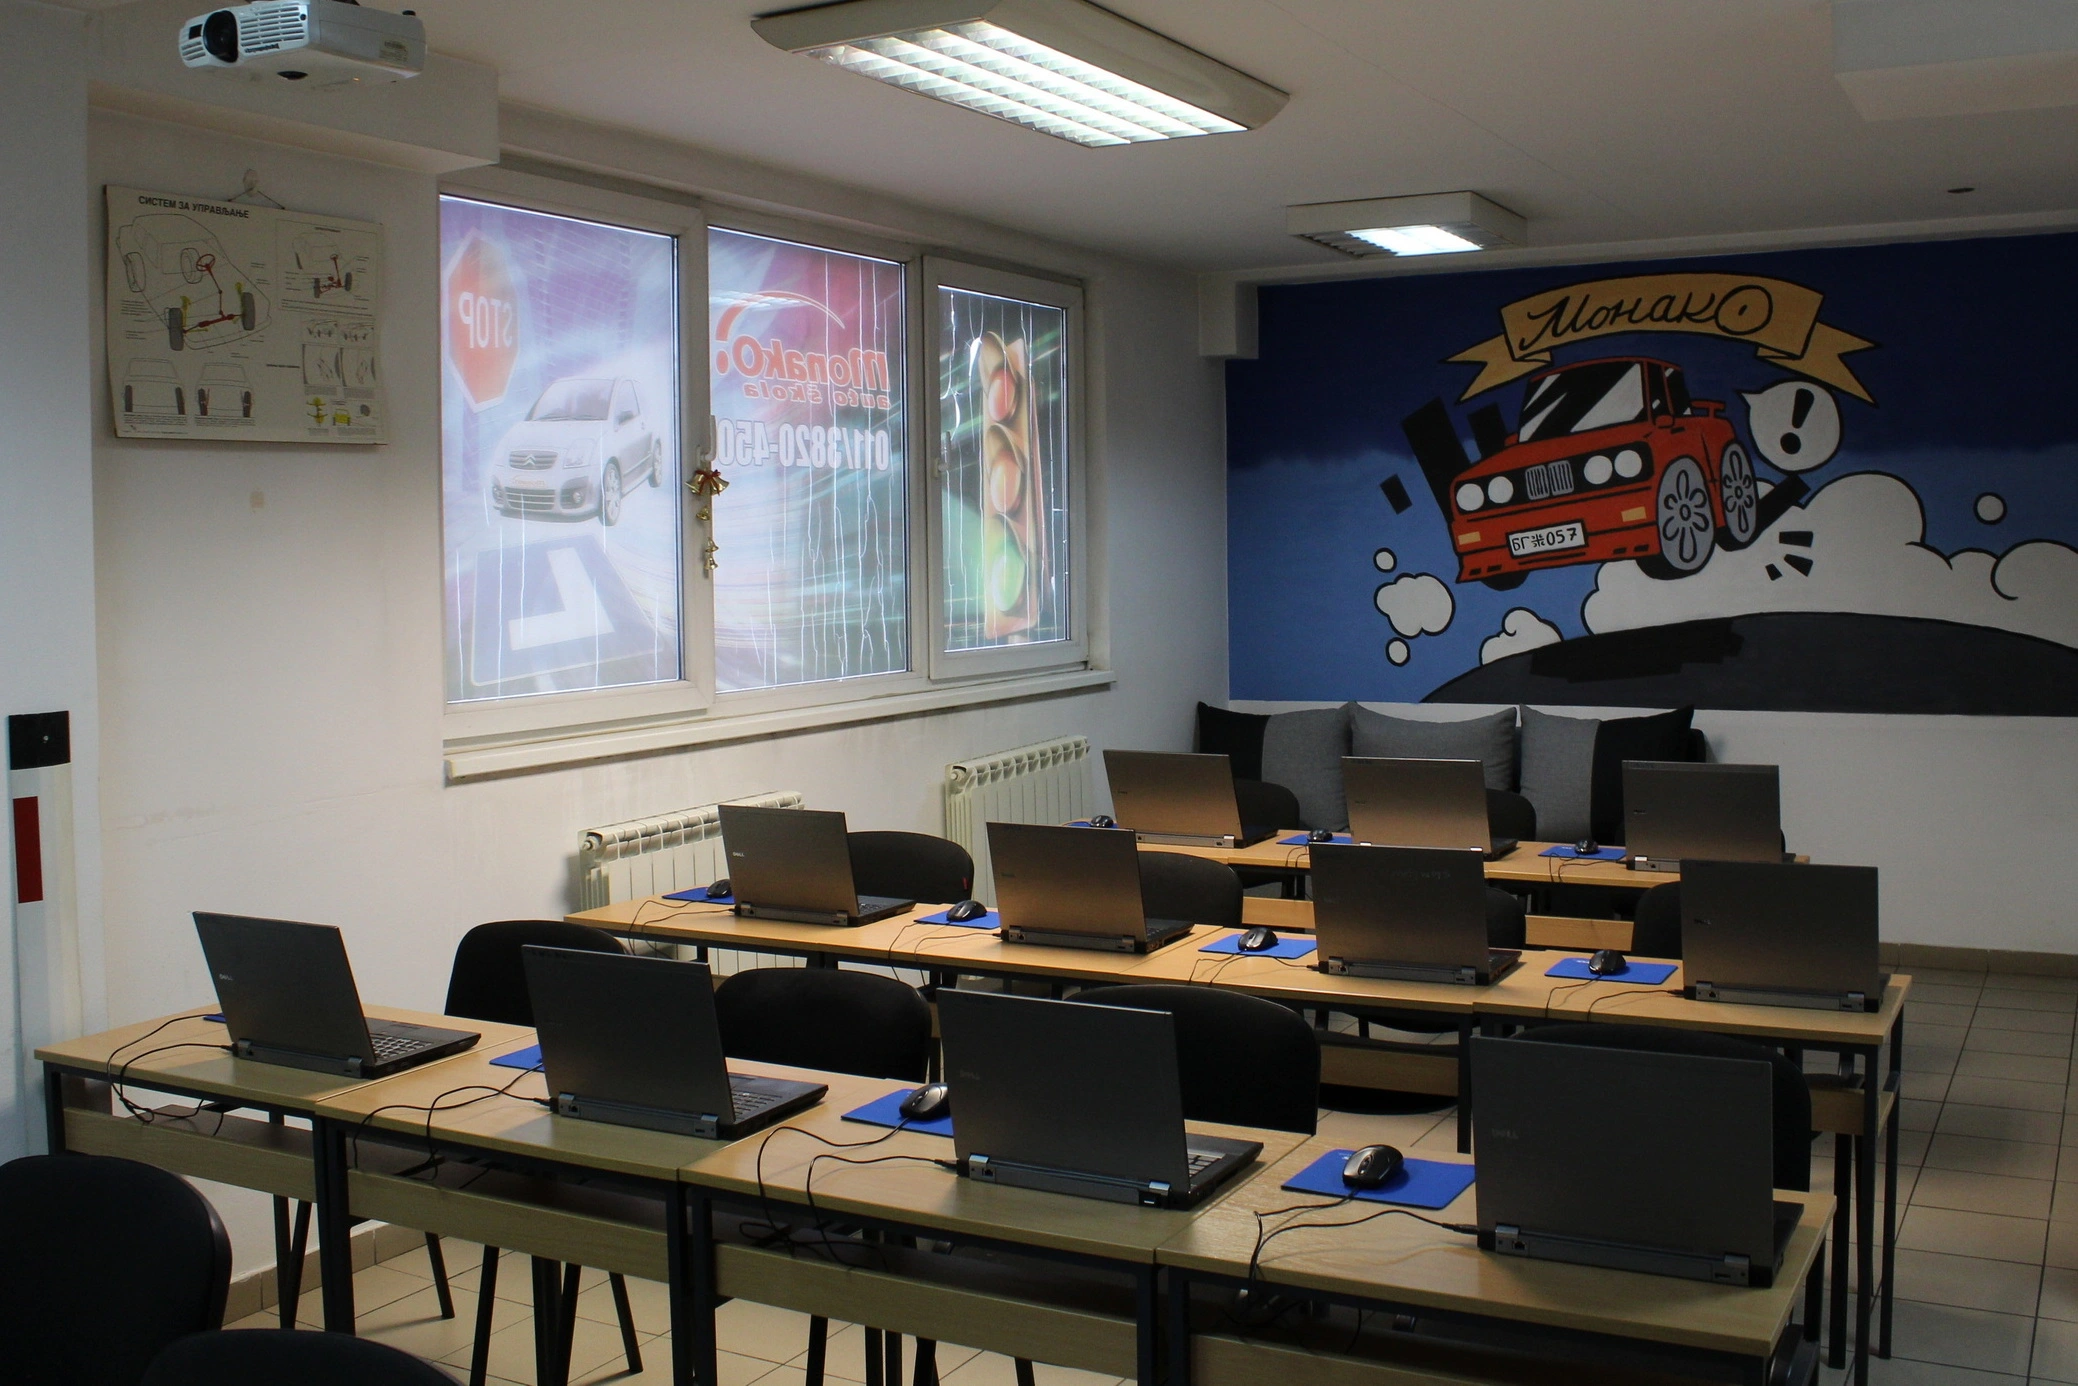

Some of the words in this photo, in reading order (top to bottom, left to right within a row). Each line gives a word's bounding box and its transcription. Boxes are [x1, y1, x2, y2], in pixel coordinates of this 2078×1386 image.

[138, 195, 176, 209] СИСТЕМ
[178, 201, 190, 211] ЗА
[192, 203, 250, 219] УПРАВЉАЊЕ
